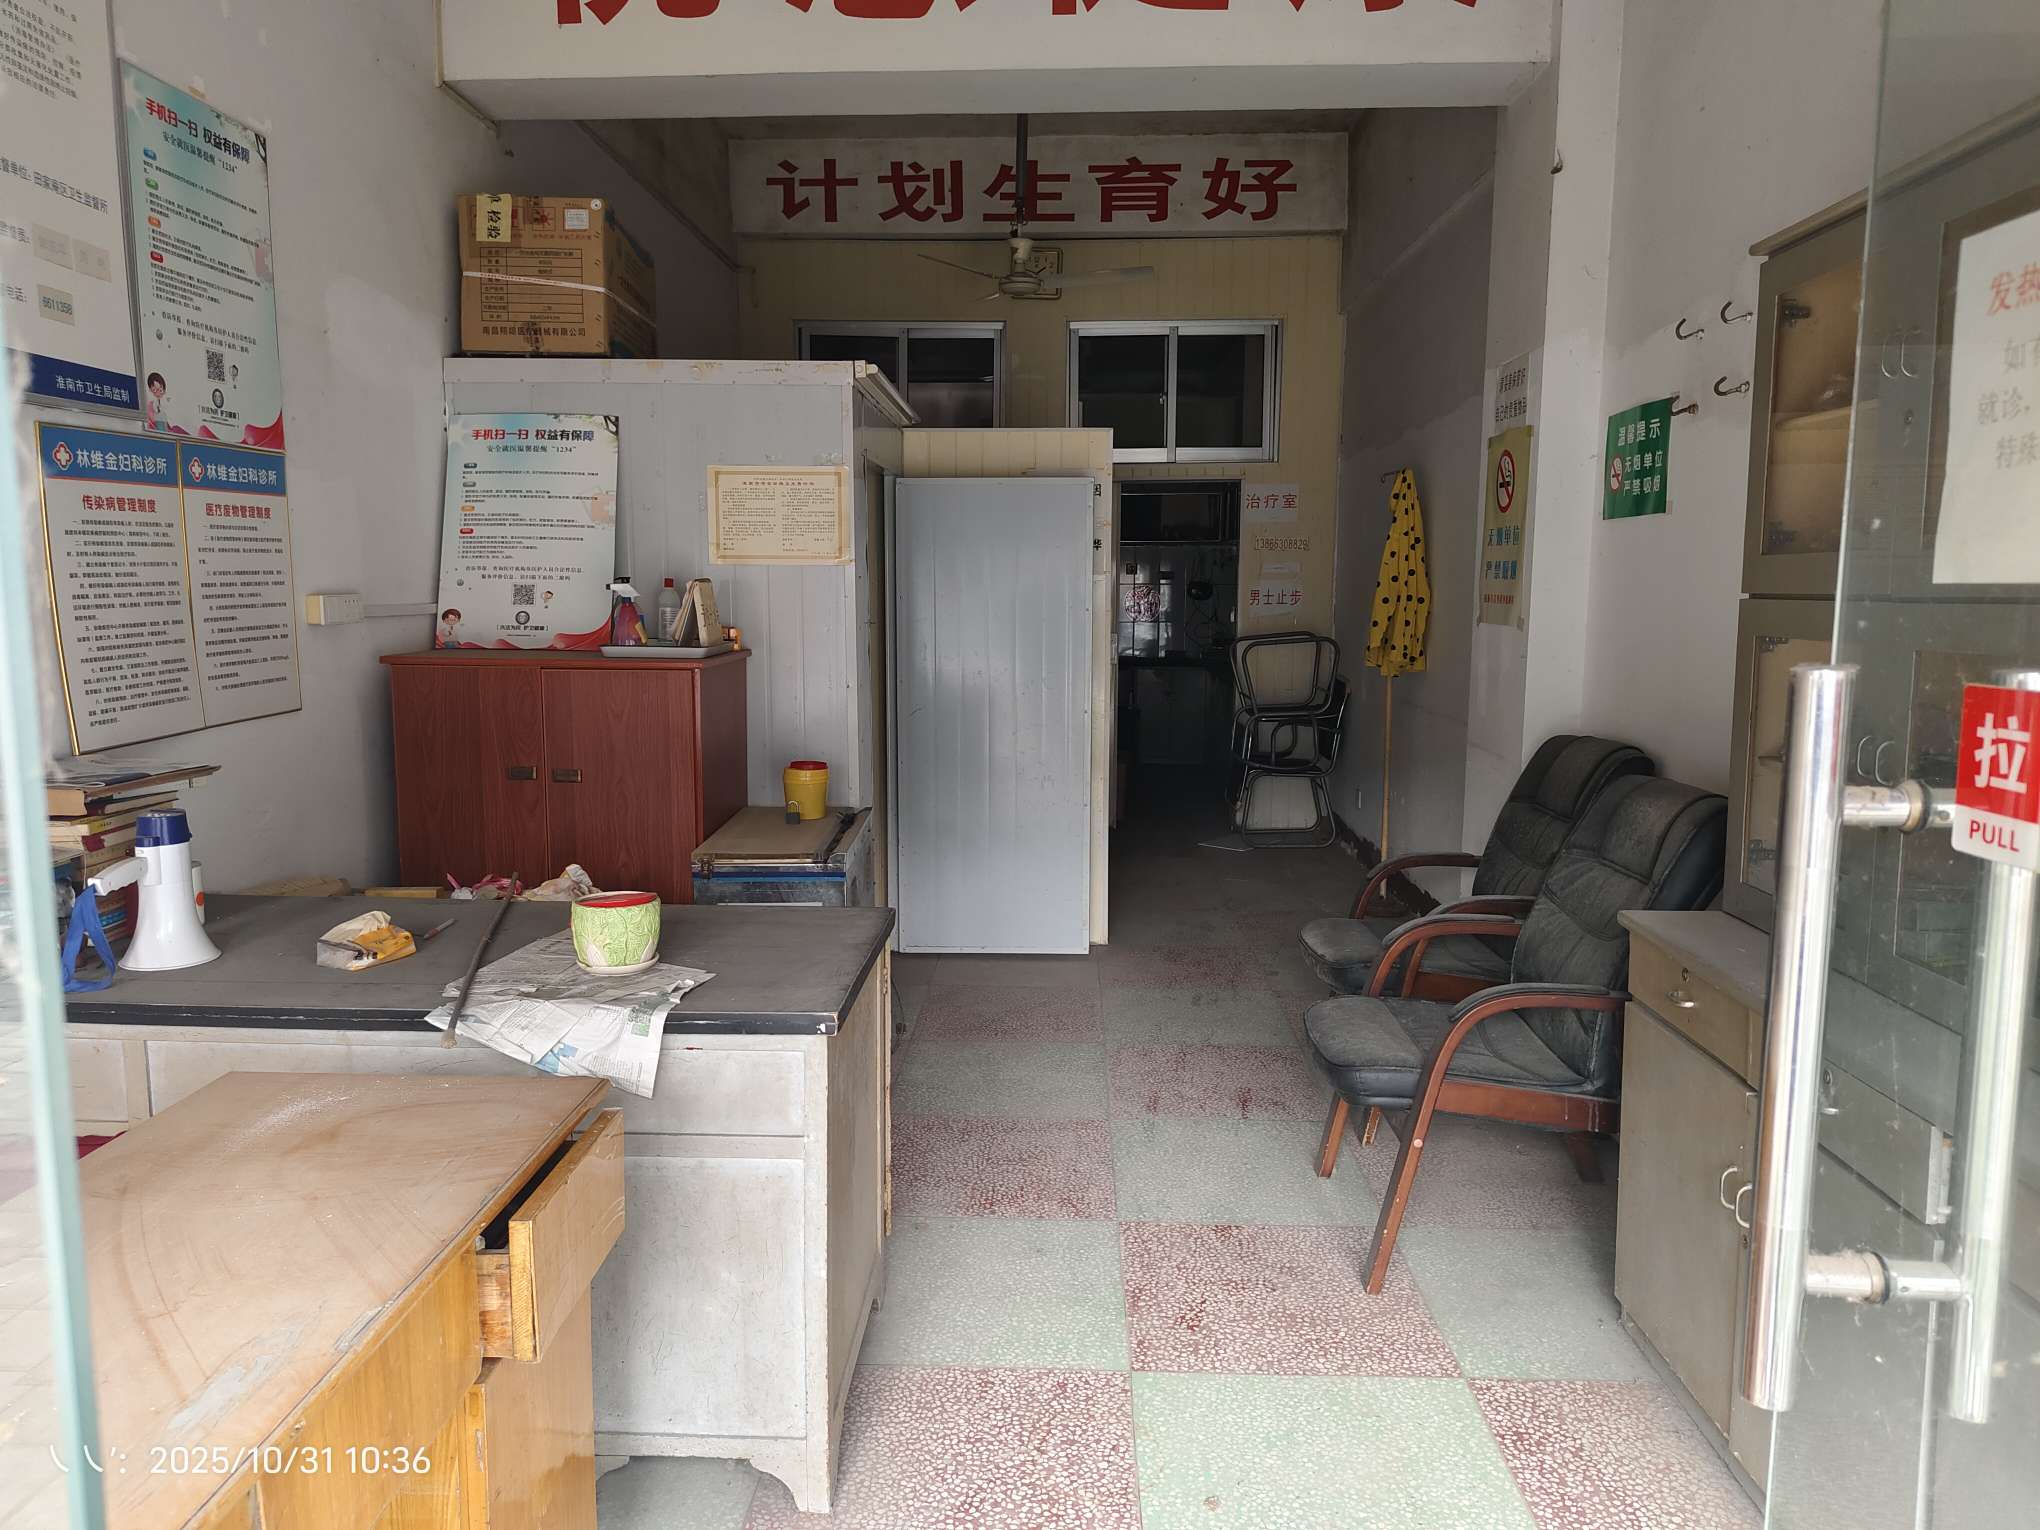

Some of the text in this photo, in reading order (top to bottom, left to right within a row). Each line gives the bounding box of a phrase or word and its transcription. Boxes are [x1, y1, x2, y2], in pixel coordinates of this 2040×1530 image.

[145, 96, 251, 164] 手机扫一扫 权益有保障
[766, 156, 1297, 223] 计划生育好
[55, 375, 130, 403] 淮南市卫生局监制
[472, 429, 595, 442] 手机扫一扫 权益有保障
[1618, 418, 1661, 446] 温馨提示
[76, 449, 168, 475] 林维金妇科诊所
[1624, 450, 1663, 473] 无烟单位
[206, 462, 278, 486] 林维金妇科诊所
[1623, 475, 1661, 496] 严禁吸烟
[82, 494, 157, 514] 传染病管理制度
[205, 503, 273, 520] 医疗废物管理制度
[1246, 493, 1298, 510] 治疗室
[1250, 589, 1304, 606] 男士止步
[1973, 713, 2031, 795] 拉
[1969, 819, 2020, 853] PULL
